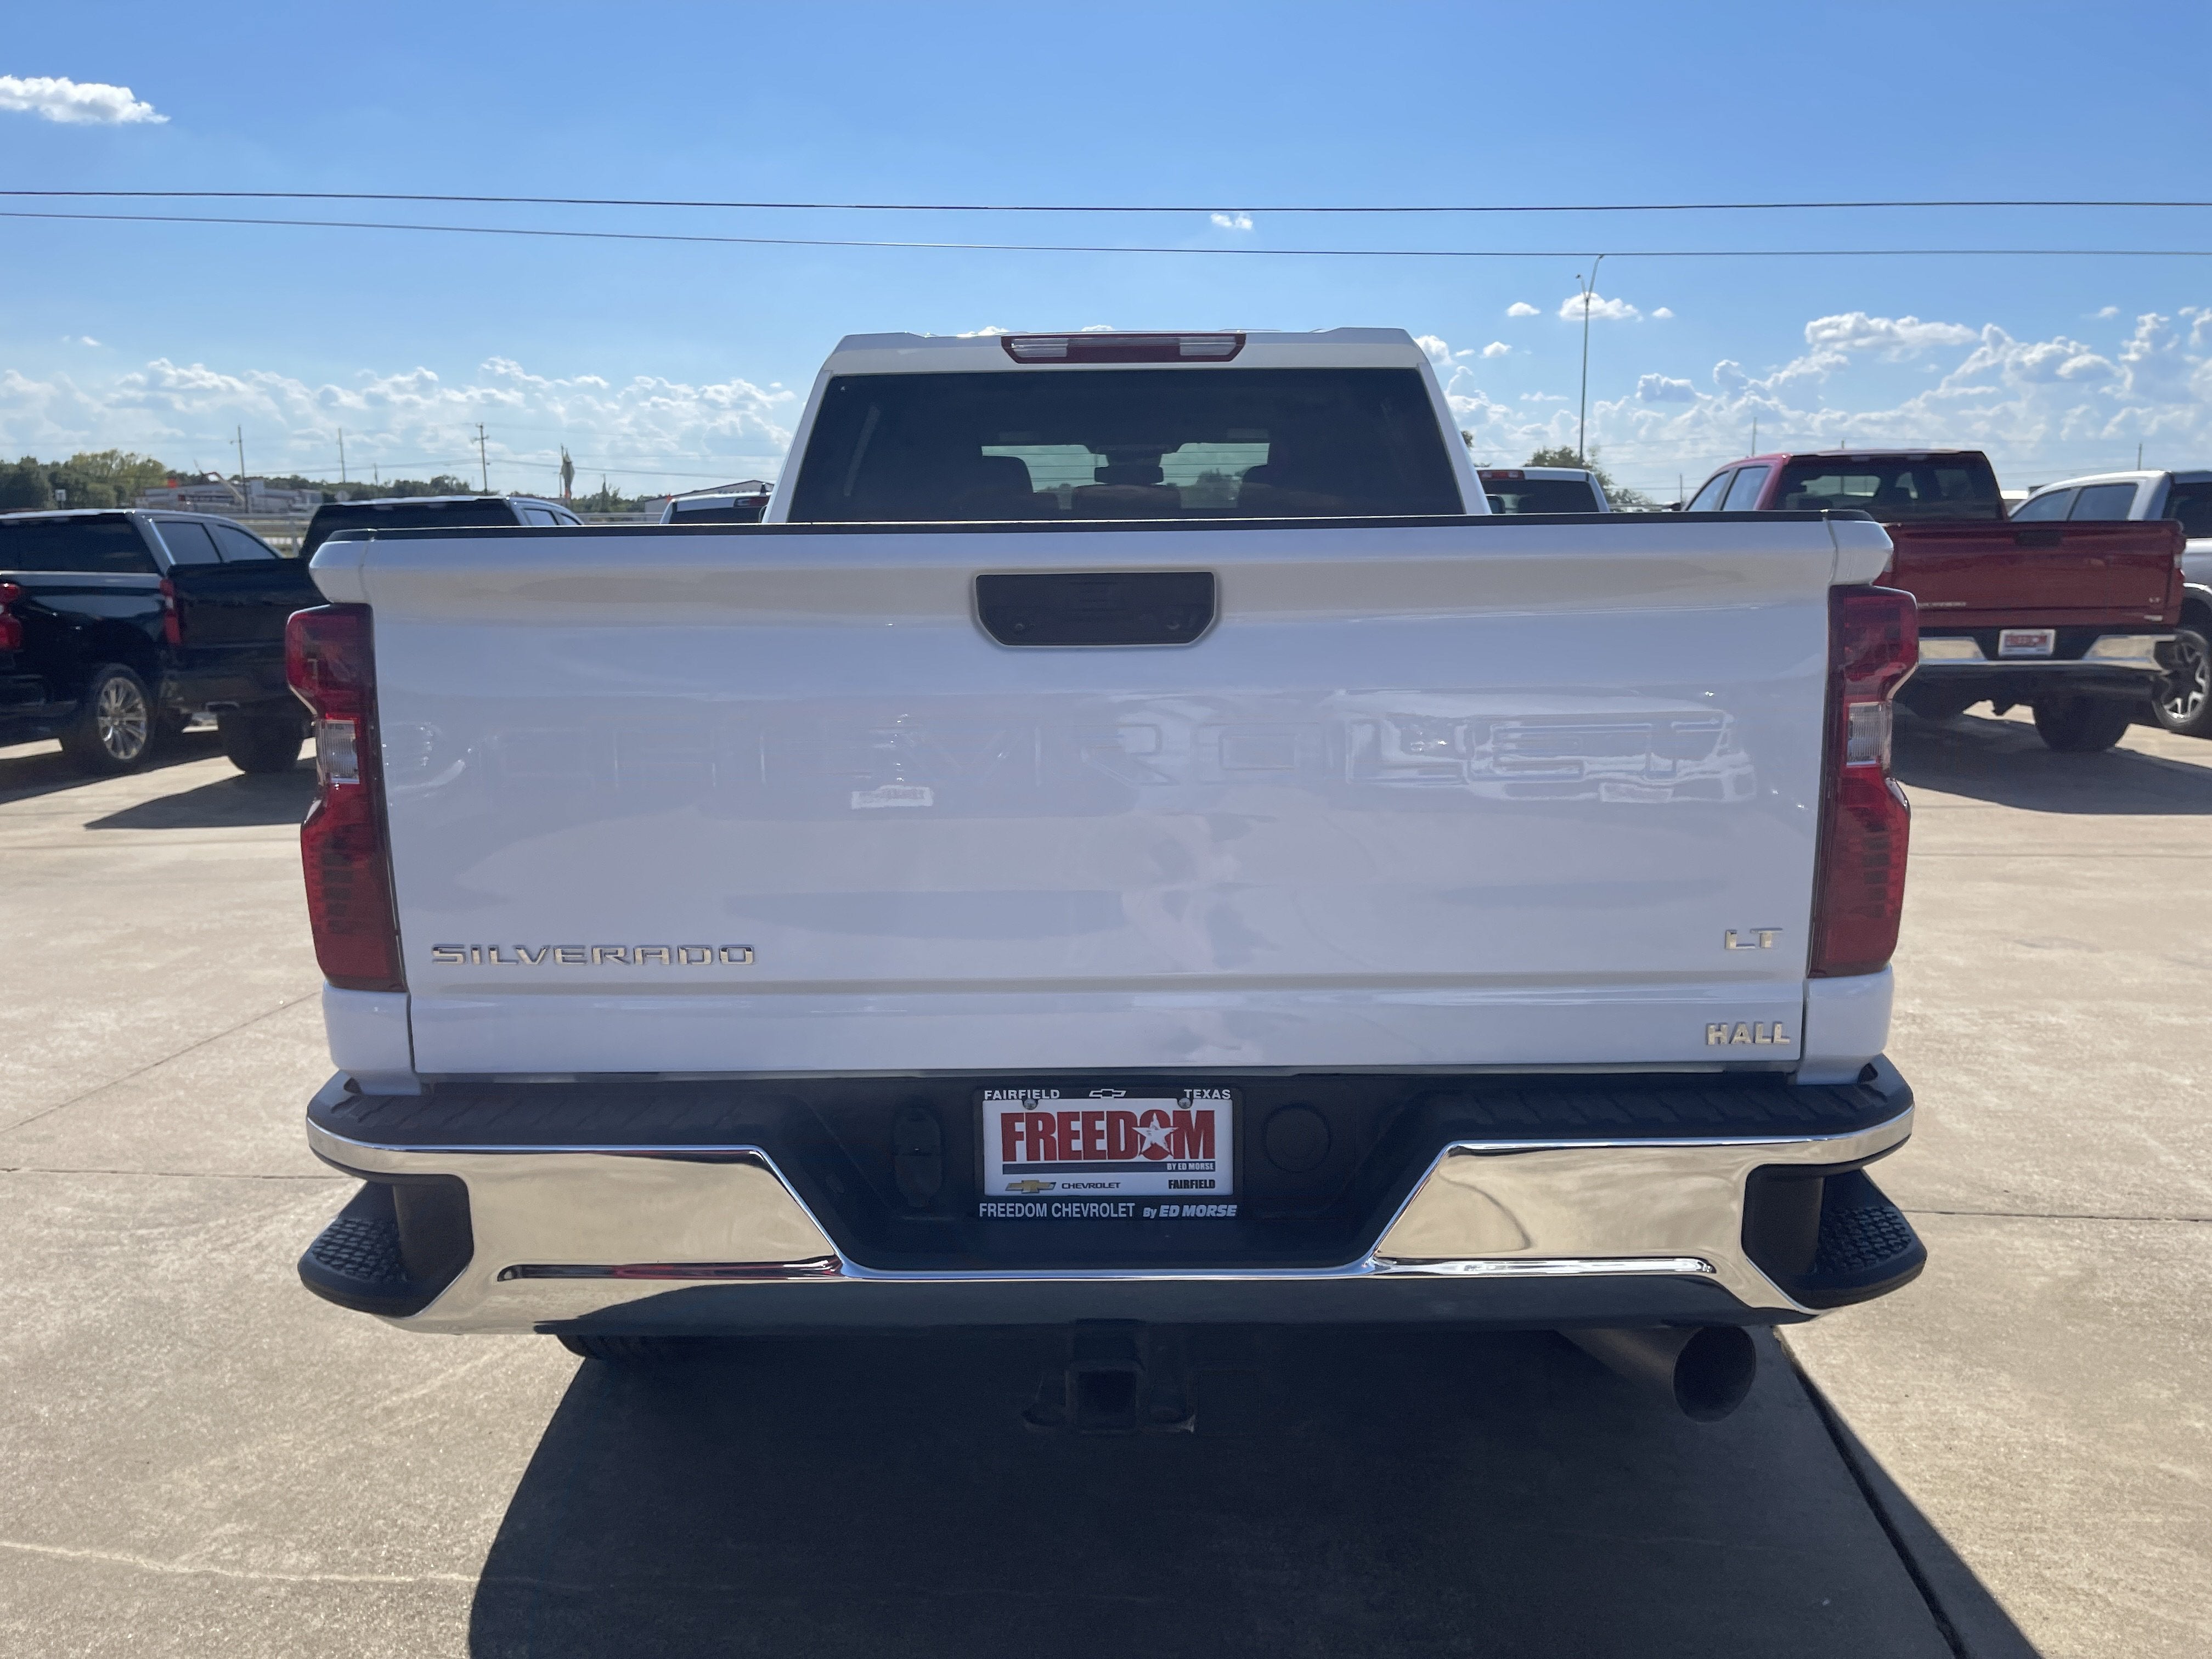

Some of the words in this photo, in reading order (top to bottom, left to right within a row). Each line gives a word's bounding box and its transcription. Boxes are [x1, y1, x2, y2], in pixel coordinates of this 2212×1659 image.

[1725, 927, 1783, 950] LT
[431, 943, 759, 966] SILVERADO
[1706, 1021, 1791, 1045] HALL
[984, 1090, 1060, 1099] FAIRFIELD
[1184, 1089, 1231, 1099] TEXAS
[1001, 1109, 1215, 1161] FREEDOM
[1168, 1180, 1216, 1189] FAIRFIELD
[979, 1203, 1047, 1217] FREEDOM
[1051, 1203, 1136, 1217] CHEVROLET
[1143, 1207, 1156, 1218] By
[1159, 1205, 1180, 1217] ED
[1182, 1205, 1237, 1217] MORSE
